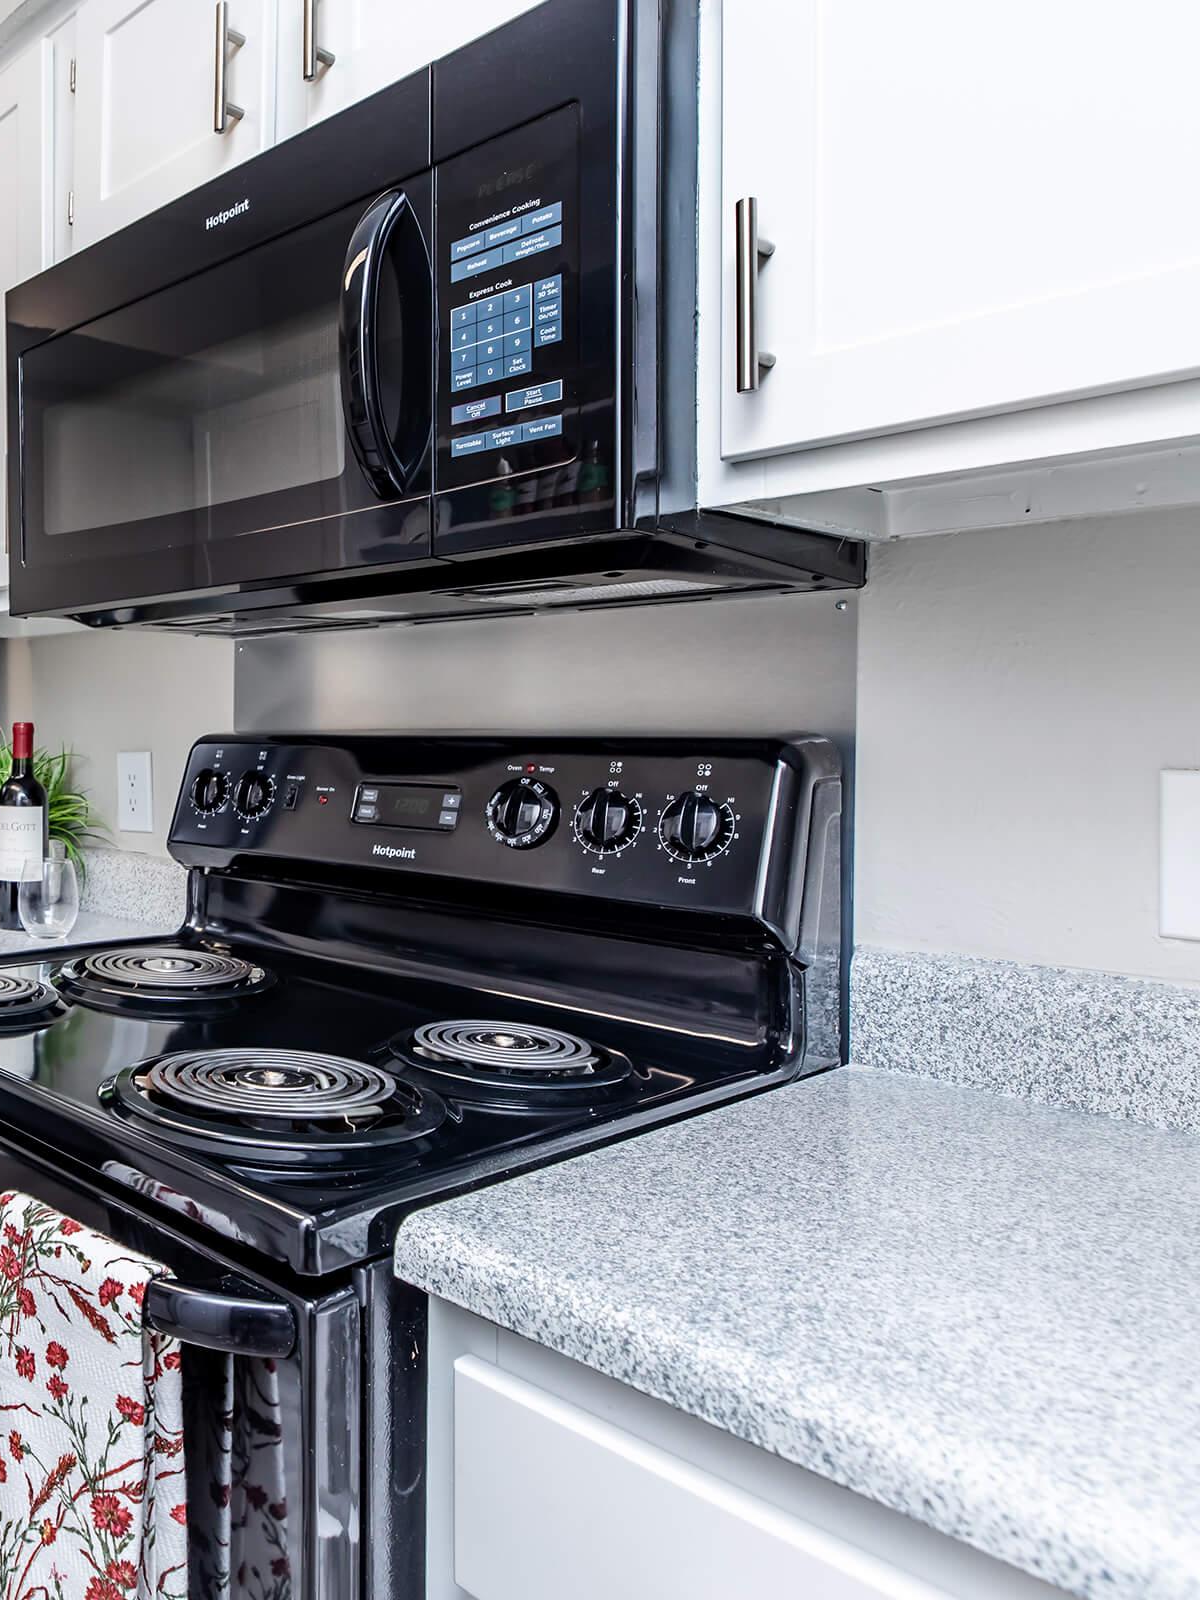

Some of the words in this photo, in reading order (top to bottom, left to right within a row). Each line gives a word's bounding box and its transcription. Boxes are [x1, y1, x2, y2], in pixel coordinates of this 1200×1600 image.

[206, 199, 249, 230] Hotpoint
[469, 210, 510, 231] Convenience
[512, 198, 541, 214] Cooking
[532, 212, 553, 224] Potato
[489, 226, 518, 240] Beverage
[521, 235, 544, 248] Defrost
[457, 240, 480, 253] Popcorn
[467, 259, 487, 270] Reheat
[469, 286, 494, 299] Express
[495, 279, 513, 290] Cook
[542, 281, 555, 290] Add
[547, 288, 559, 296] Sec
[539, 304, 557, 313] Timer
[488, 325, 493, 333] 5
[540, 326, 556, 336] Cook
[540, 334, 556, 342] Time
[462, 354, 466, 362] 7
[509, 364, 526, 373] Clock
[456, 379, 472, 387] Level
[524, 397, 543, 405] Pause
[466, 402, 486, 411] Cancel
[492, 430, 515, 439] Surface
[529, 426, 543, 434] Vent
[496, 436, 511, 445] Light
[372, 844, 416, 859] Hotpoint
